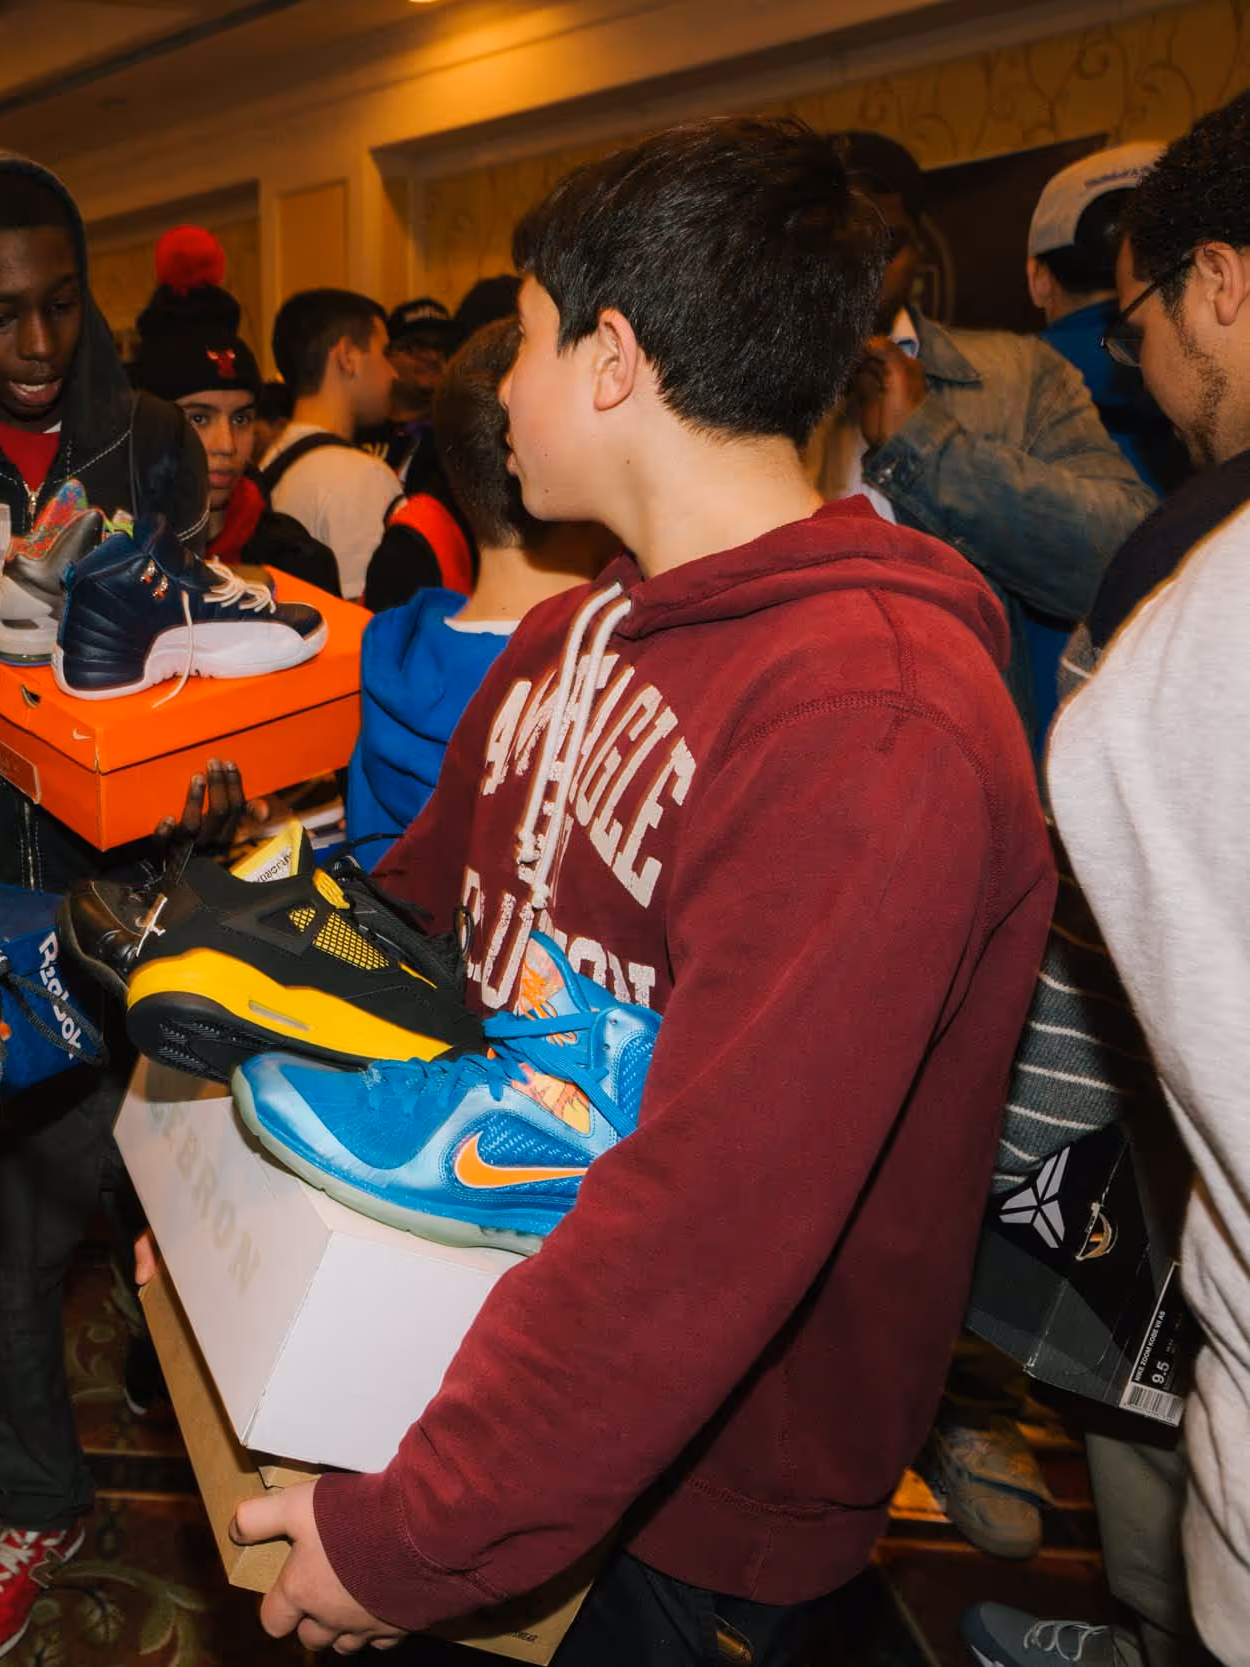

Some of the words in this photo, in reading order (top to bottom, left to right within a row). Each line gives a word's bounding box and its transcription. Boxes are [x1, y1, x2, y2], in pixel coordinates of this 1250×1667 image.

[1134, 1366, 1144, 1381] NIKE
[1141, 1346, 1152, 1366] ZOOM
[1148, 1328, 1158, 1346] KOBE
[1151, 1360, 1169, 1384] 9.5
